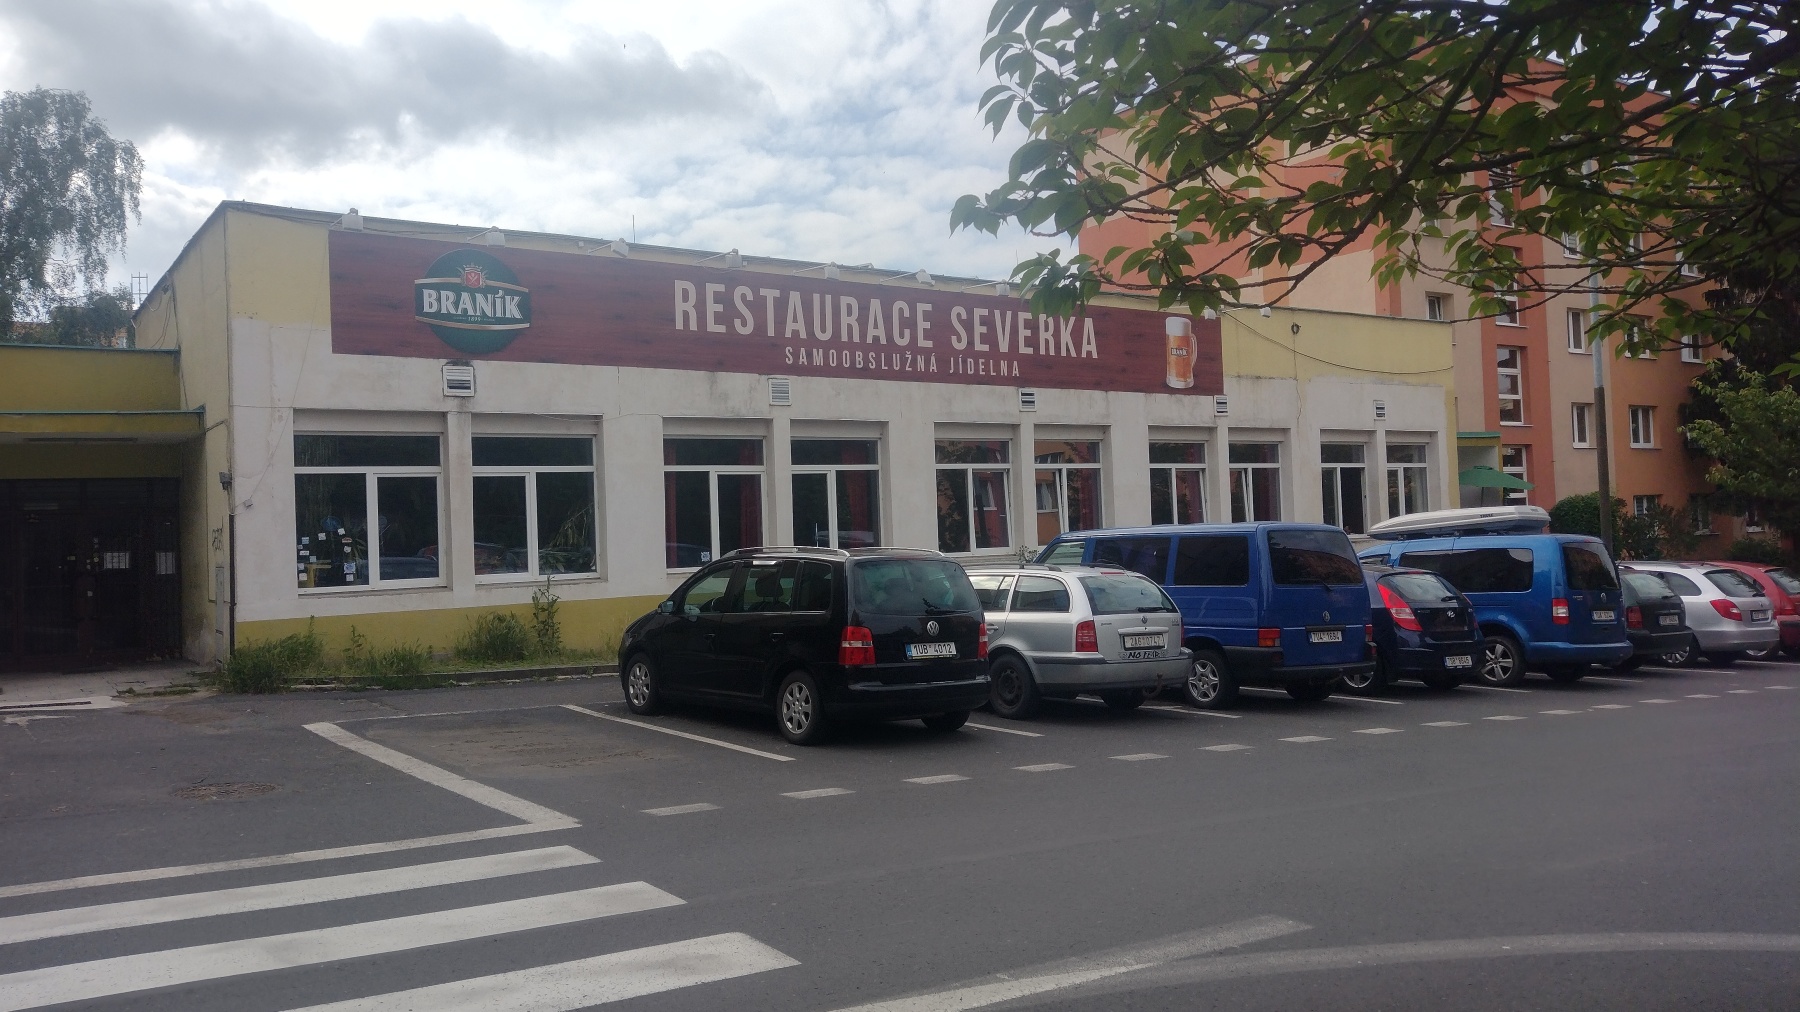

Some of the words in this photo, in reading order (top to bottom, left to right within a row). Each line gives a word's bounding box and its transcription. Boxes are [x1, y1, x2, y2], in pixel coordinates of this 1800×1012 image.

[422, 288, 524, 319] BRANÍK
[674, 279, 934, 348] RESTAURACE
[950, 305, 1099, 359] SEVERKA
[785, 346, 938, 373] SAMOOBSLUŽNÁ
[949, 354, 1020, 377] JÍDELNA
[913, 644, 929, 655] 1UB
[933, 643, 953, 654] 4012
